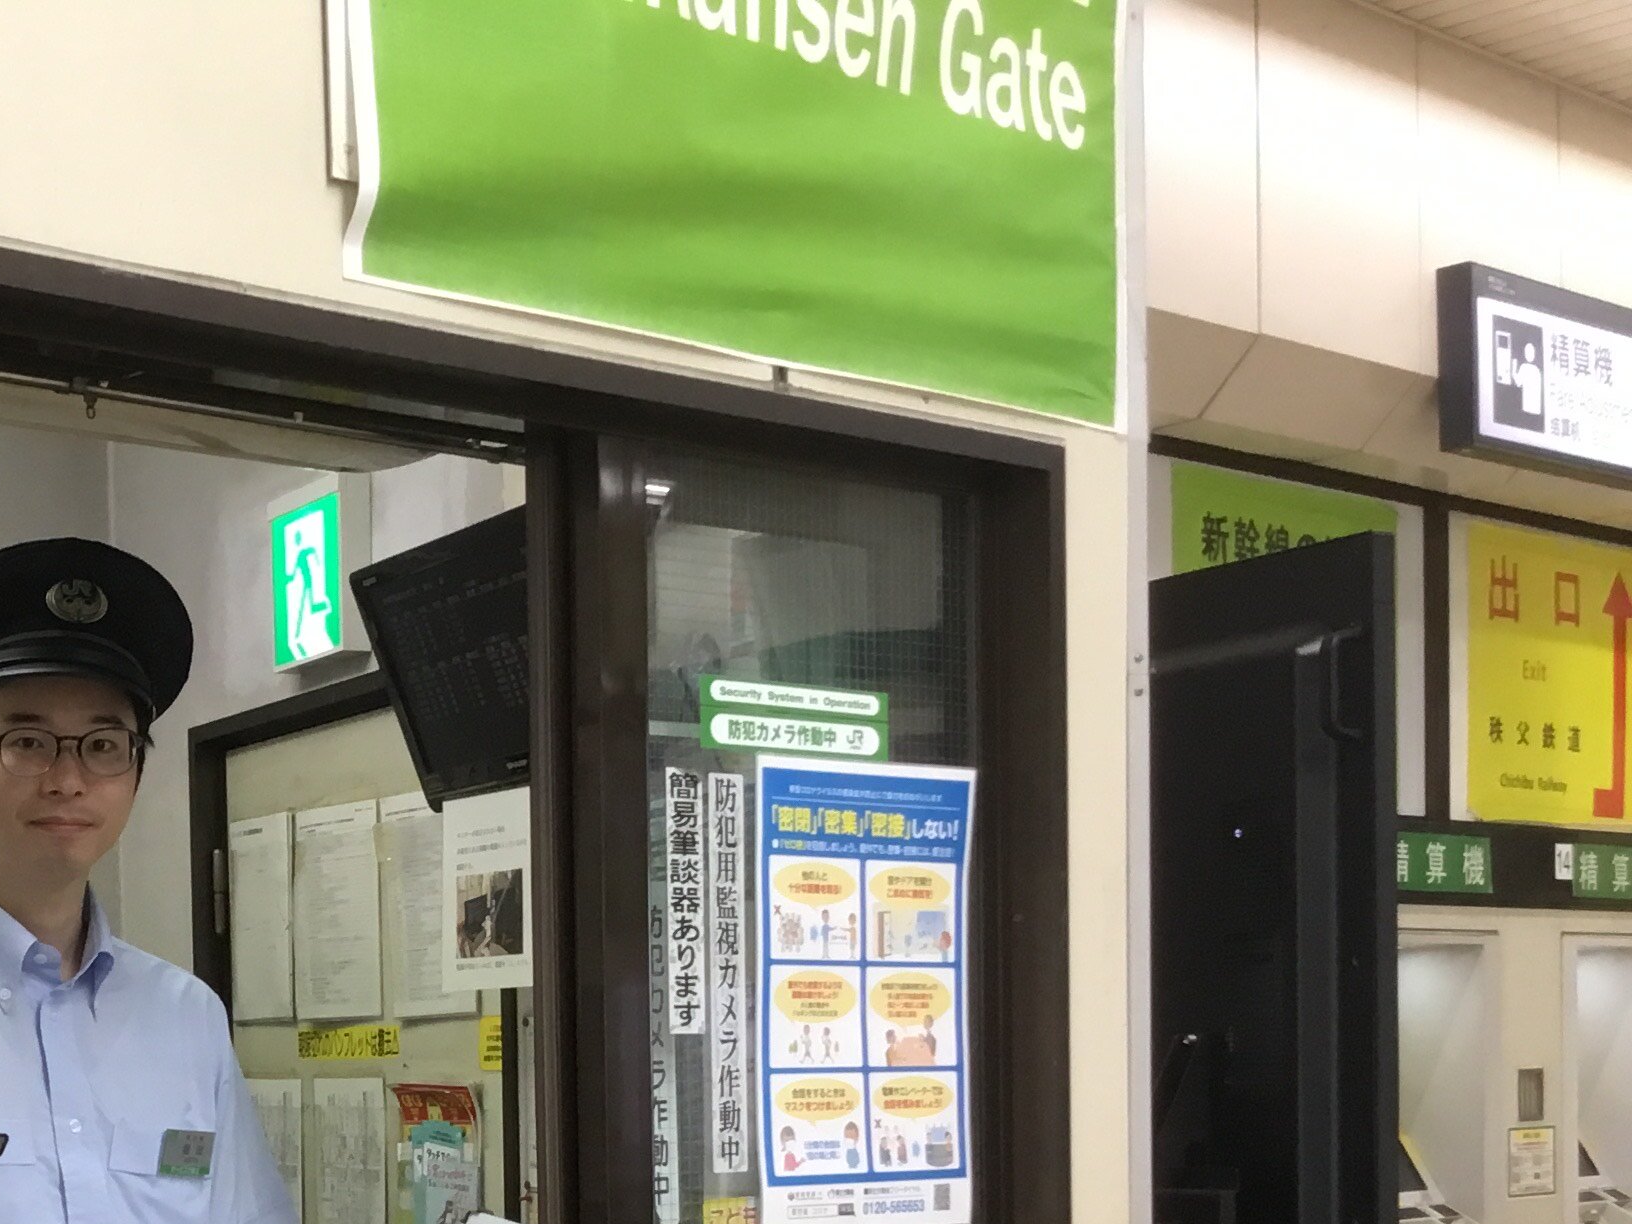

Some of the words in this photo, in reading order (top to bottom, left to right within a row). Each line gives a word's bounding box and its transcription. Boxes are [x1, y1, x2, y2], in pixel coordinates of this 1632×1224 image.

[939, 0, 1087, 150] Gate
[1550, 334, 1613, 387] 精算機
[1489, 555, 1579, 627] 出口
[1522, 660, 1547, 681] Exit
[720, 685, 762, 700] Security
[768, 691, 803, 704] System
[809, 695, 818, 705] in
[823, 697, 871, 710] Operation
[728, 719, 837, 748] 防犯カメラ作動中
[1489, 716, 1581, 752] 秩父鉄道
[669, 772, 701, 1027] 簡易筆談器あります
[714, 777, 741, 1170] 防犯用監視カメラ作動中
